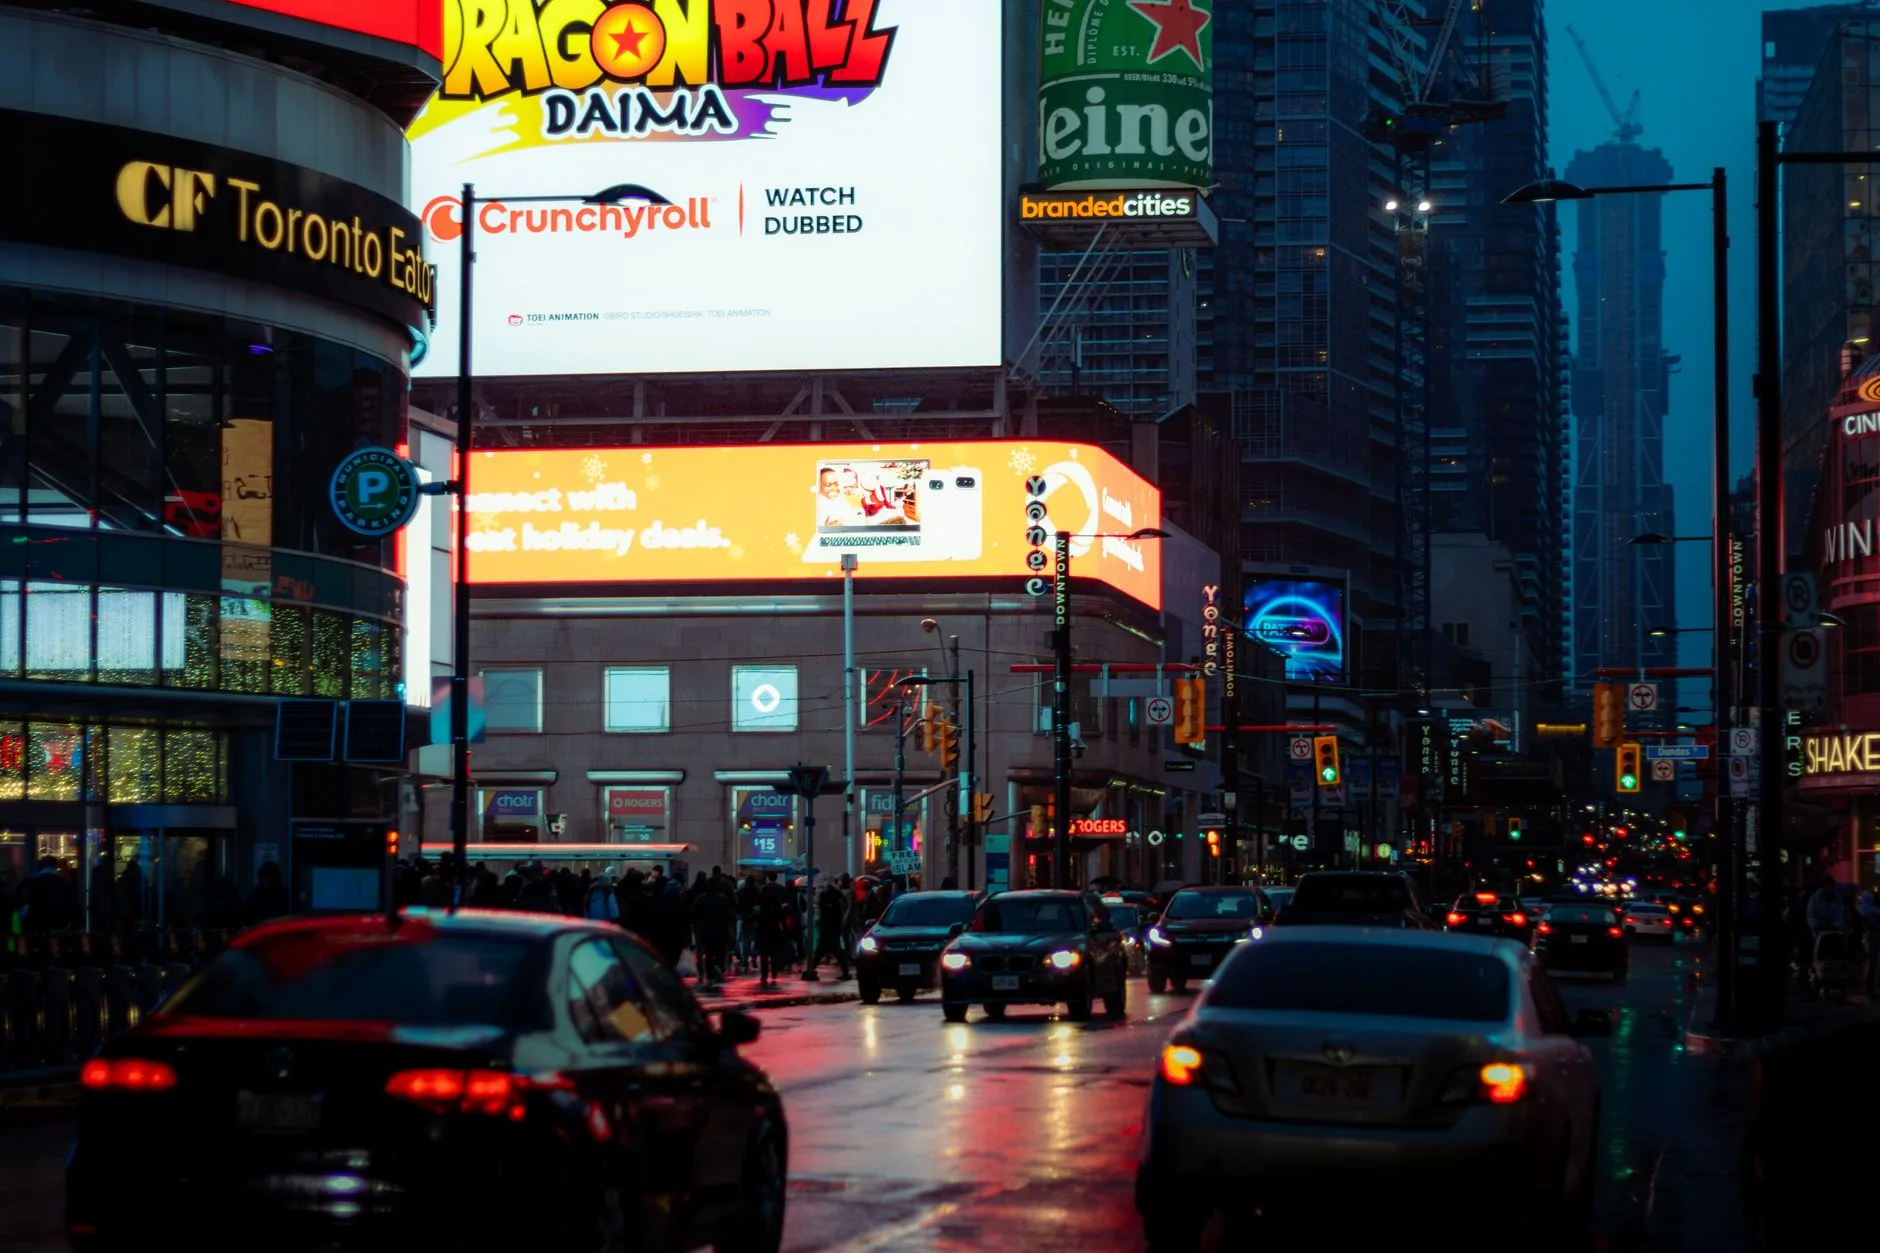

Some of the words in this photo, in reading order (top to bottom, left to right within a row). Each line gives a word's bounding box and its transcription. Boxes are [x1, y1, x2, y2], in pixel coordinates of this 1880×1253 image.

[443, 0, 711, 98] RAGON
[1113, 45, 1140, 56] EST.
[545, 92, 733, 135] DAIMA
[1041, 86, 1213, 165] eine
[1072, 161, 1165, 171] ORIGINAL
[765, 187, 855, 208] WATCH
[1022, 193, 1191, 219] brandedcities
[116, 160, 216, 231] CF
[228, 177, 382, 277] Toronto
[479, 197, 711, 239] Crunchyroll
[764, 215, 863, 235] DUBBED
[527, 313, 546, 322] TOEI
[548, 312, 600, 321] ANIMATION
[727, 308, 771, 317] ANIMATION
[338, 453, 407, 484] MUNICIPAL
[358, 471, 390, 503] P
[567, 481, 637, 512] with
[338, 495, 408, 528] PARKING
[522, 520, 635, 557] holiday
[640, 519, 731, 548] deals.
[1025, 475, 1047, 597] Yonge
[1055, 538, 1067, 626] DOWNTOWN
[1733, 541, 1743, 628] DOWNTOWN
[1203, 584, 1220, 677] Yonge
[1226, 632, 1235, 697] DOWNTOWN
[1658, 747, 1690, 757] Dundas
[1806, 733, 1880, 774] SHAKE
[497, 795, 534, 809] chatr
[624, 798, 664, 808] ROGERS
[751, 794, 789, 807] chatr
[871, 794, 893, 810] fid
[1076, 819, 1126, 833] ROGERS
[754, 838, 776, 851] $15
